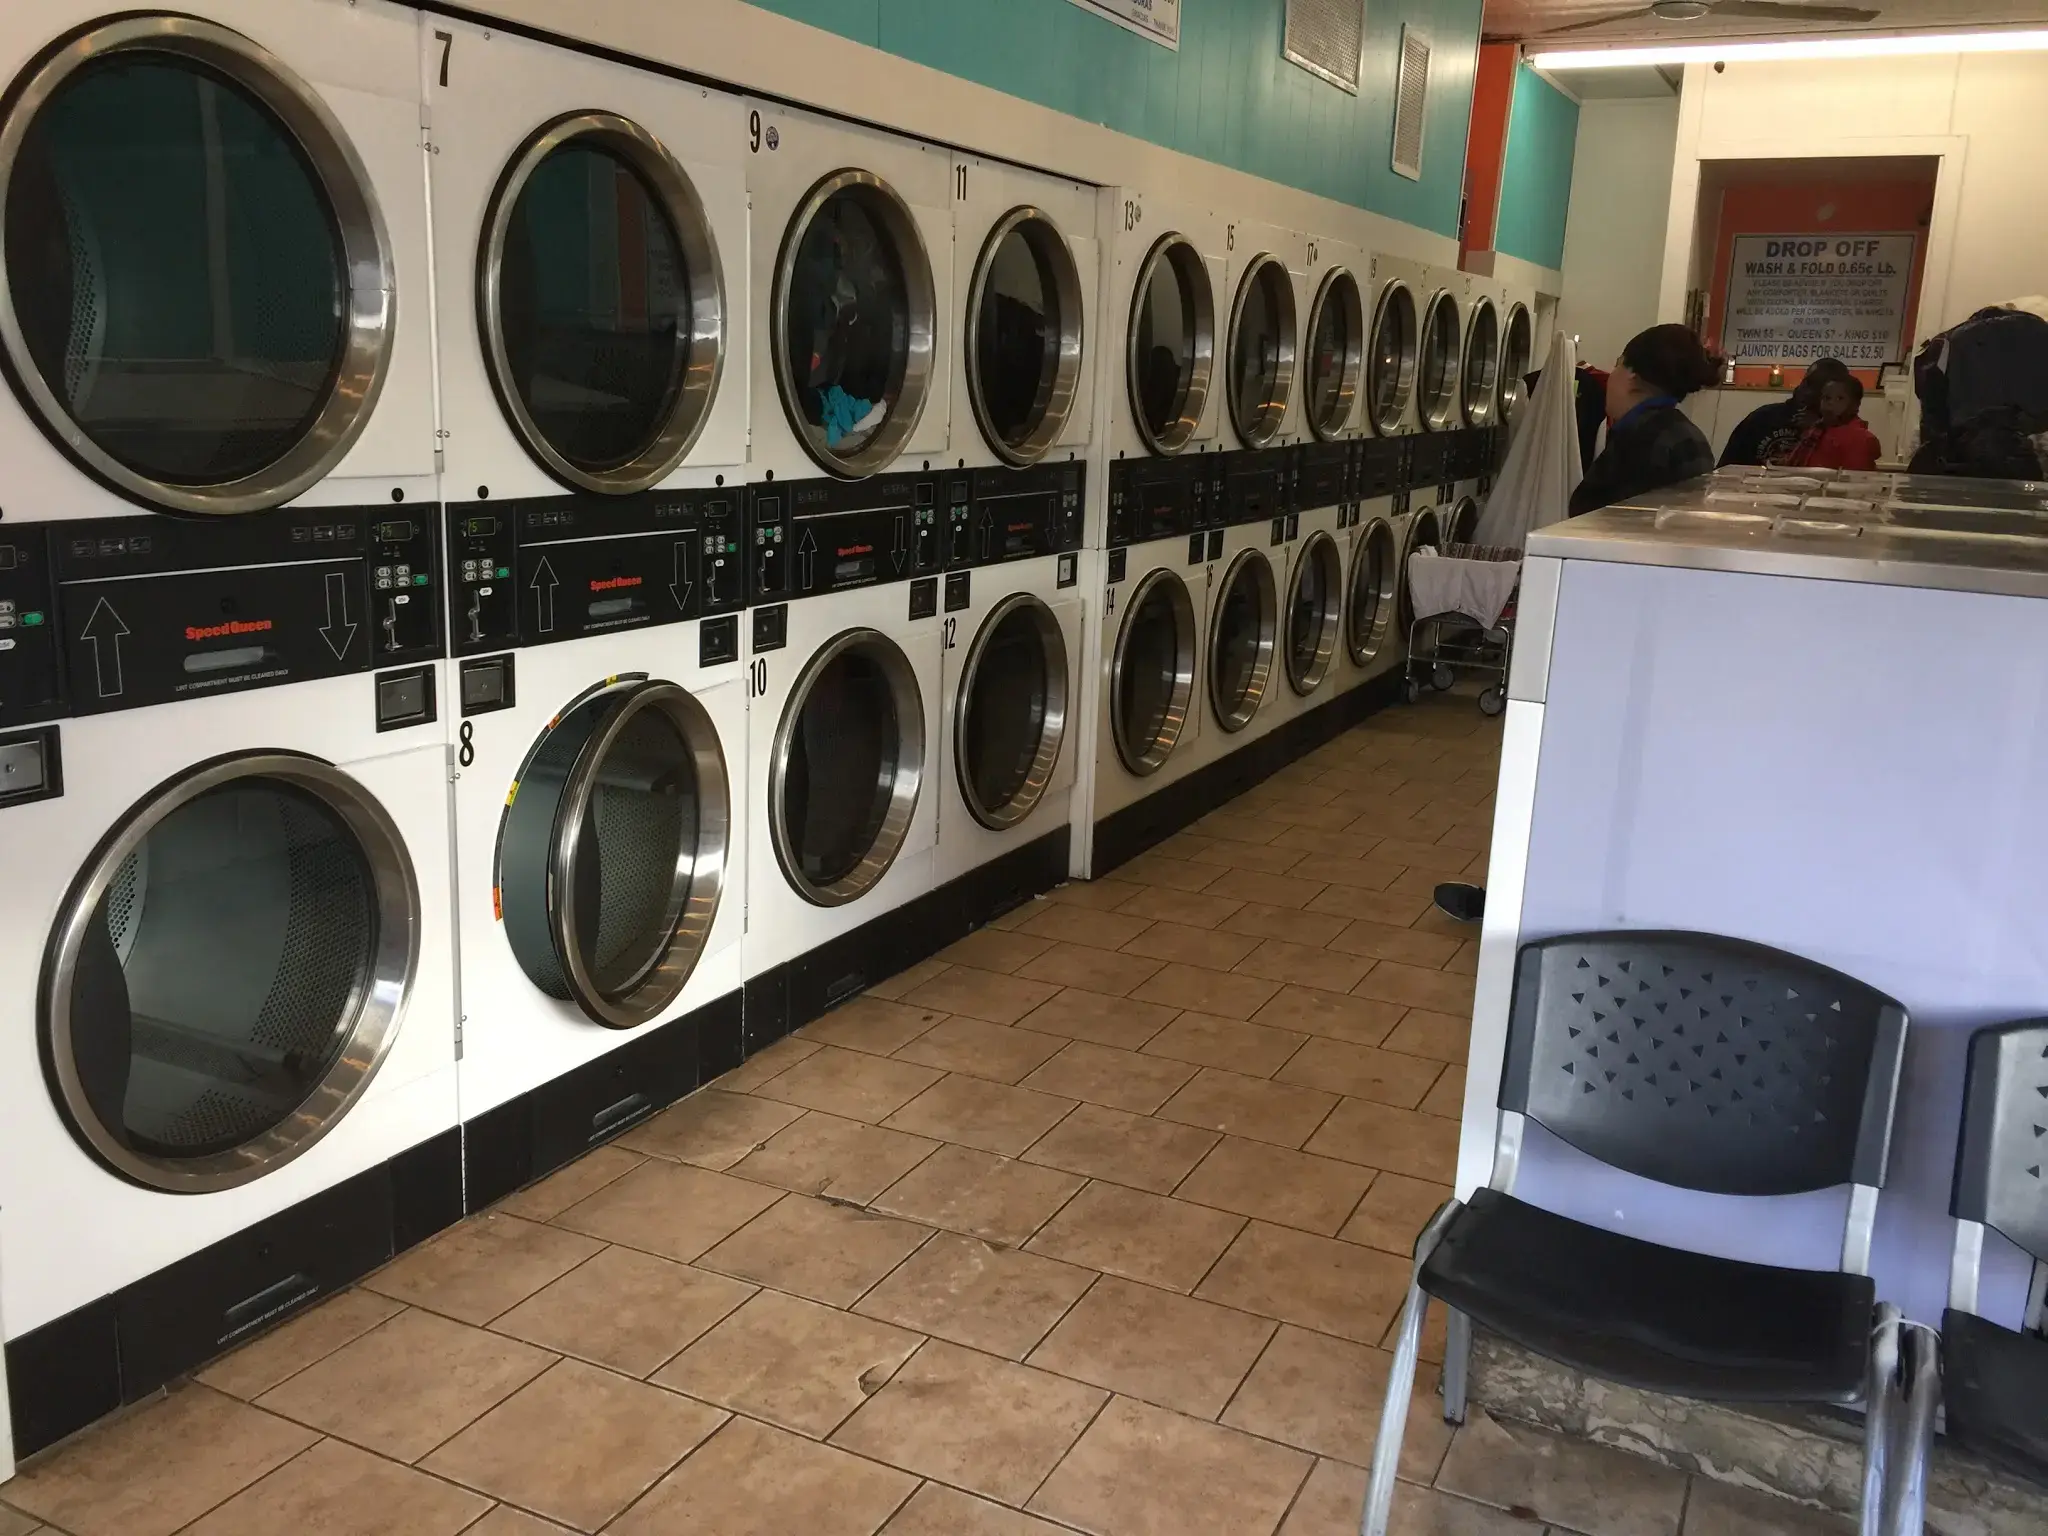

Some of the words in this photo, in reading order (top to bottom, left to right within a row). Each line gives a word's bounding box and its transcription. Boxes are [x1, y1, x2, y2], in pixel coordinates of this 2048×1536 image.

[435, 30, 452, 87] 7
[750, 110, 760, 153] 9
[956, 164, 967, 201] 11
[1124, 200, 1134, 231] 13
[1226, 224, 1235, 251] 15
[1766, 241, 1827, 257] DROP
[1836, 240, 1880, 256] OFF
[1745, 262, 1783, 274] WASH
[1786, 263, 1796, 274] &
[1800, 262, 1834, 274] FOLD
[1737, 329, 1761, 339] TWIN
[1763, 328, 1774, 339] $5
[1787, 329, 1822, 339] QUEEN
[1824, 329, 1836, 340] $7
[1845, 329, 1869, 340] KING
[1736, 344, 1779, 358] LAUNDRY
[1781, 344, 1809, 358] BAGS
[1811, 344, 1830, 359] FOR
[1832, 345, 1858, 359] SALE
[1860, 346, 1885, 360] $2.50
[1106, 587, 1115, 615] 14
[185, 622, 230, 641] Speed
[230, 620, 272, 634] Queen
[943, 617, 957, 650] 12
[749, 658, 767, 698] 10
[459, 720, 474, 767] 8
